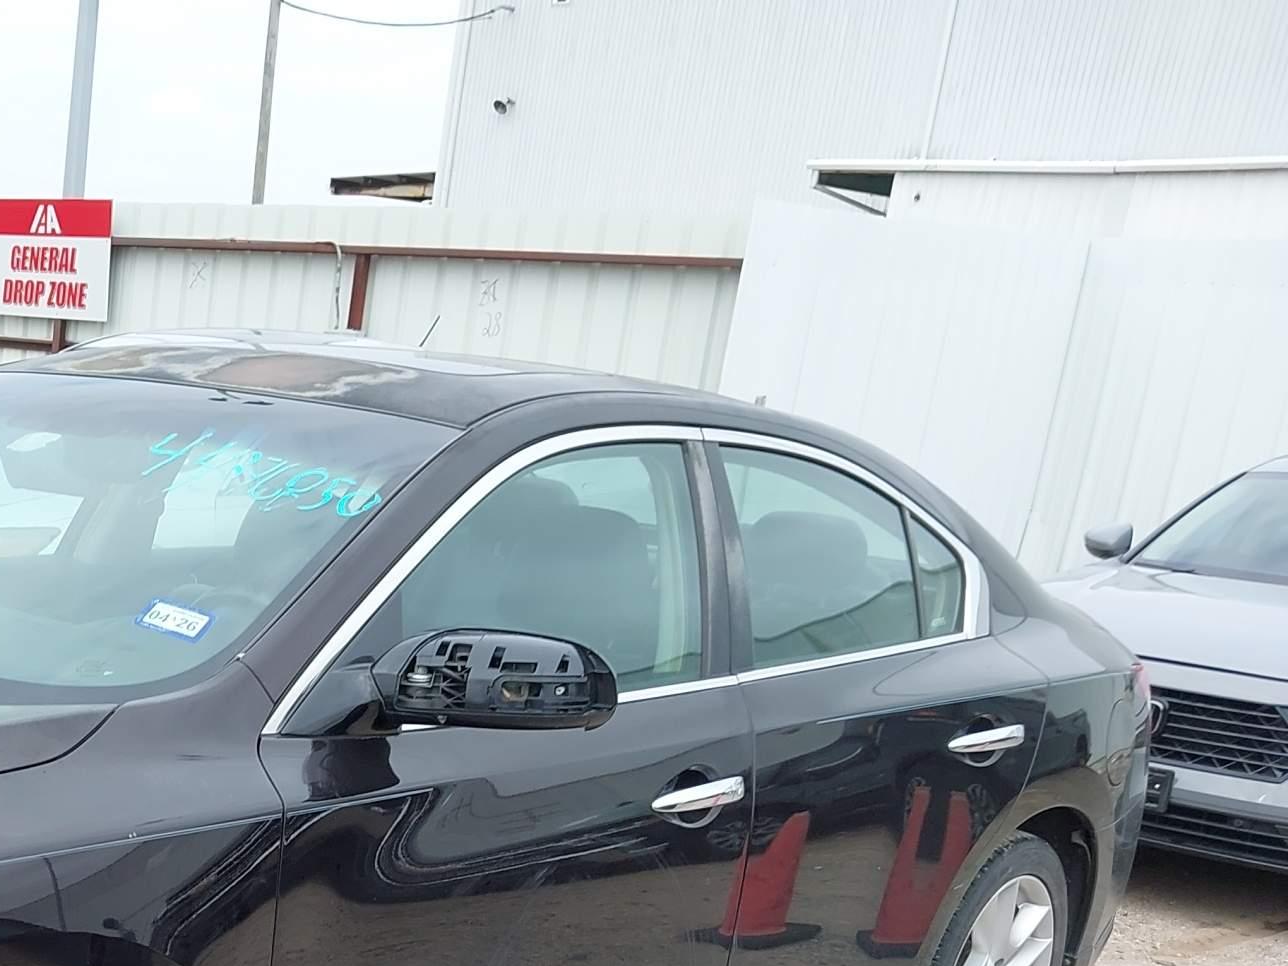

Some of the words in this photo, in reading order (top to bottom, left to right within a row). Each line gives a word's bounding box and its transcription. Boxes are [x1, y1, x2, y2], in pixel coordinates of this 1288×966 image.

[10, 245, 77, 273] GENERAL
[2, 279, 45, 306] DROP
[47, 281, 89, 310] ZONE
[482, 311, 503, 338] 28
